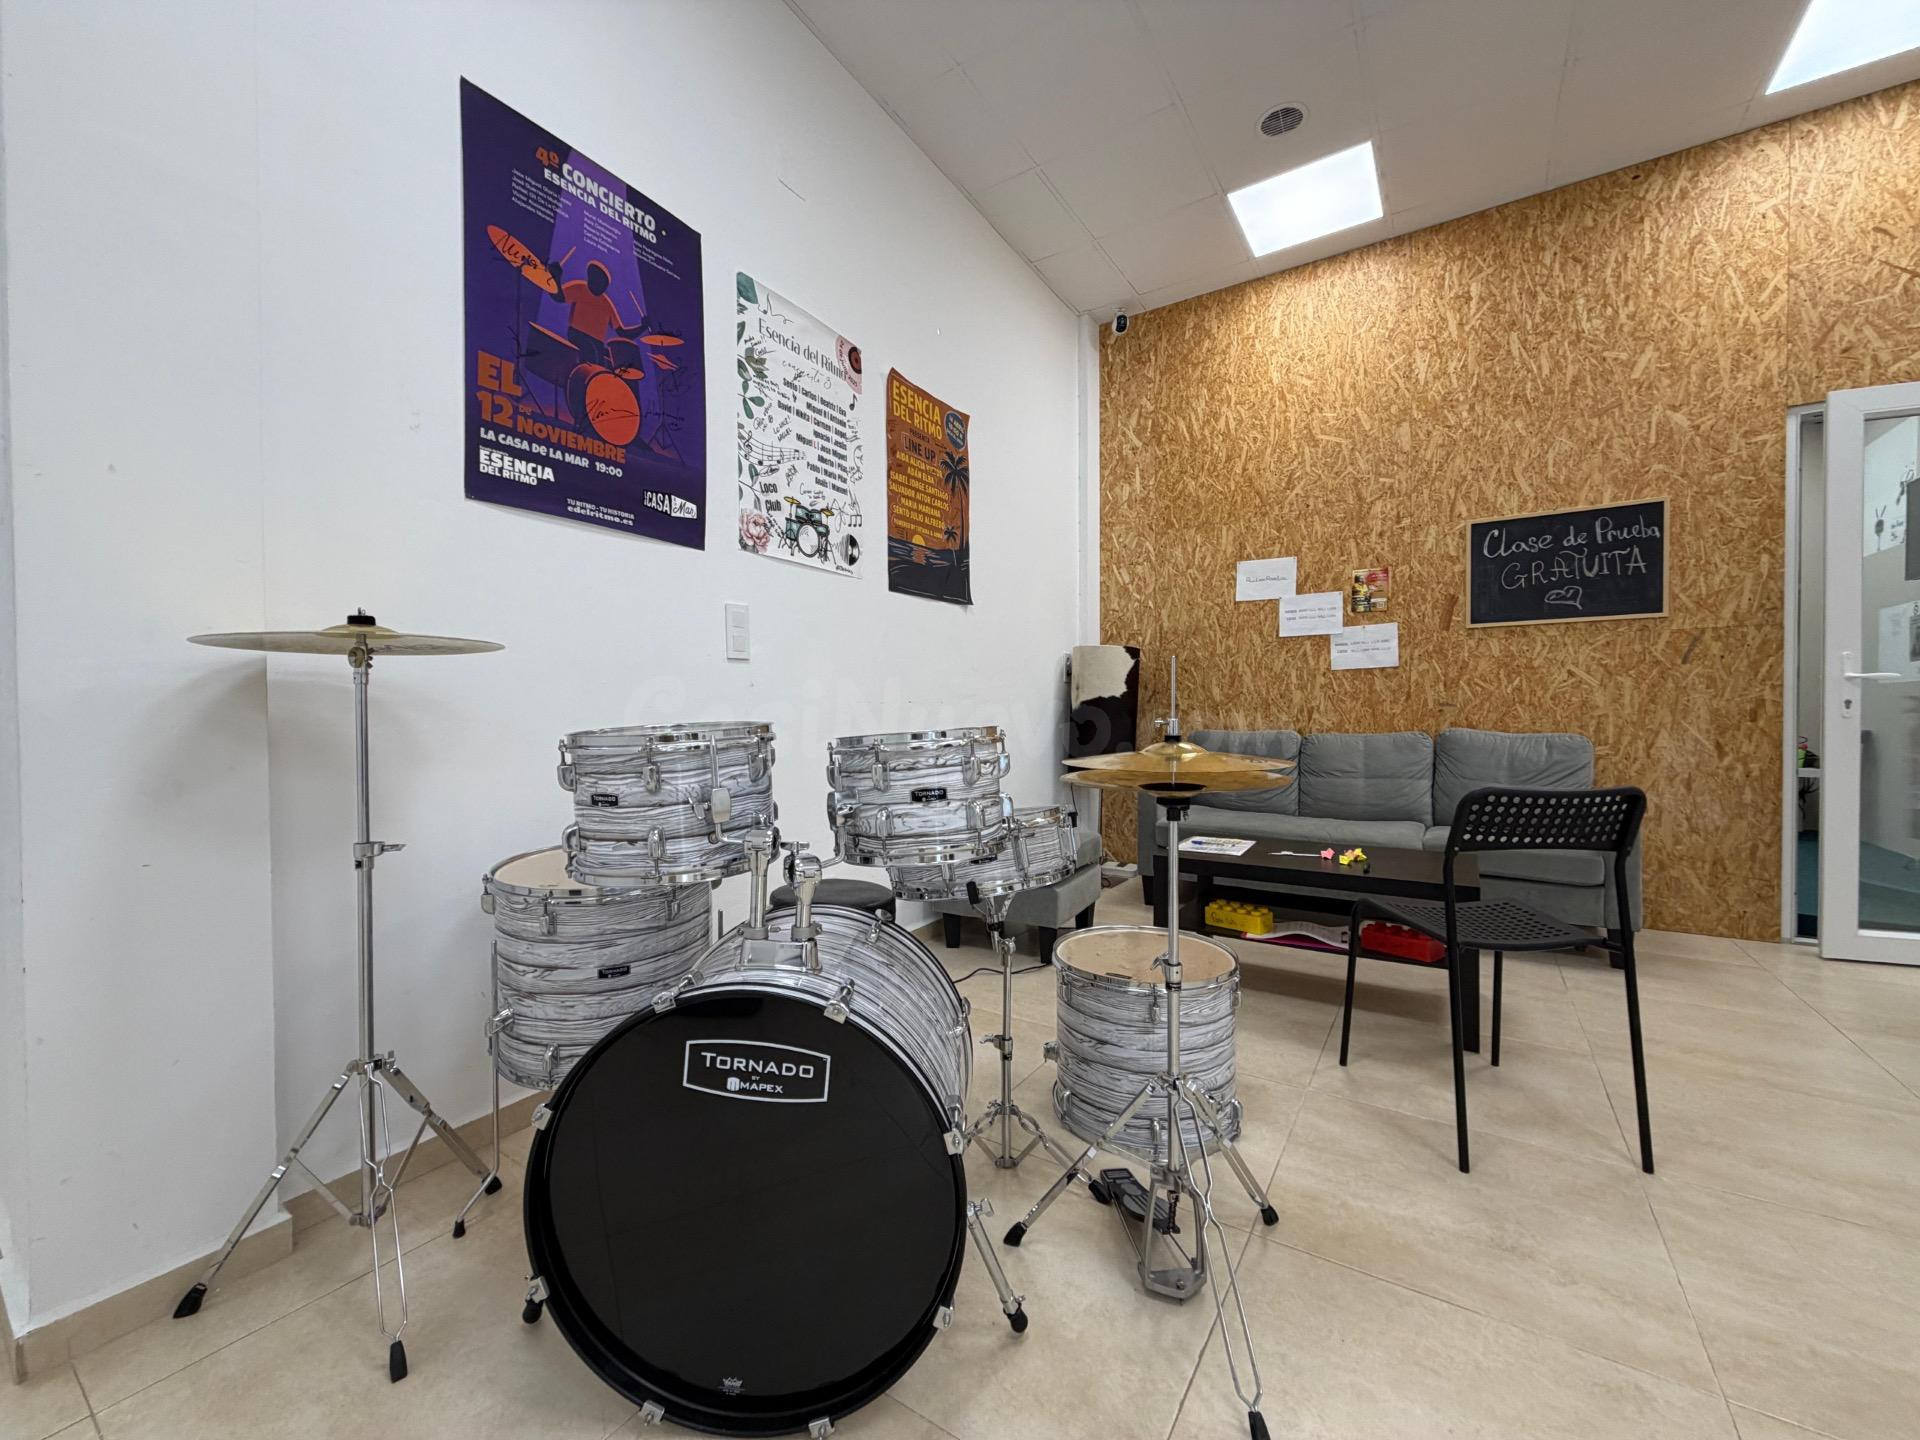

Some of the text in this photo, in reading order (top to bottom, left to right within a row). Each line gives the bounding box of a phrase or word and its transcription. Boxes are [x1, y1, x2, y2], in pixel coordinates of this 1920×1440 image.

[544, 167, 597, 208] ESENCIA
[600, 202, 622, 223] DEL
[622, 215, 657, 244] RITMO
[562, 163, 656, 232] CONCIERTO
[759, 317, 801, 356] Esencia
[803, 345, 819, 366] del
[477, 350, 523, 398] EL
[476, 391, 514, 429] 12
[892, 380, 941, 425] ESENCIA
[893, 401, 912, 424] DEL
[914, 412, 943, 441] RITMO
[480, 427, 497, 441] LA
[498, 434, 530, 452] CASA
[549, 447, 563, 461] LA
[564, 453, 590, 468] MAR
[595, 461, 623, 478] 19:00
[517, 415, 627, 465] NOVIEMBRE
[904, 436, 922, 457] LINE
[924, 446, 936, 461] UP
[479, 449, 555, 482] ESENCIA
[480, 463, 538, 486] DEL RITMO
[646, 491, 671, 515] CASA
[759, 481, 778, 495] Loco
[765, 499, 782, 512] Club
[889, 481, 916, 499] SALVADOR
[567, 505, 634, 526] edelritmo.es
[1483, 514, 1662, 558] Clase de Prueba
[1501, 544, 1648, 590] GRATUITA
[701, 1051, 815, 1079] TORNADO
[739, 1080, 784, 1094] MAPEX
